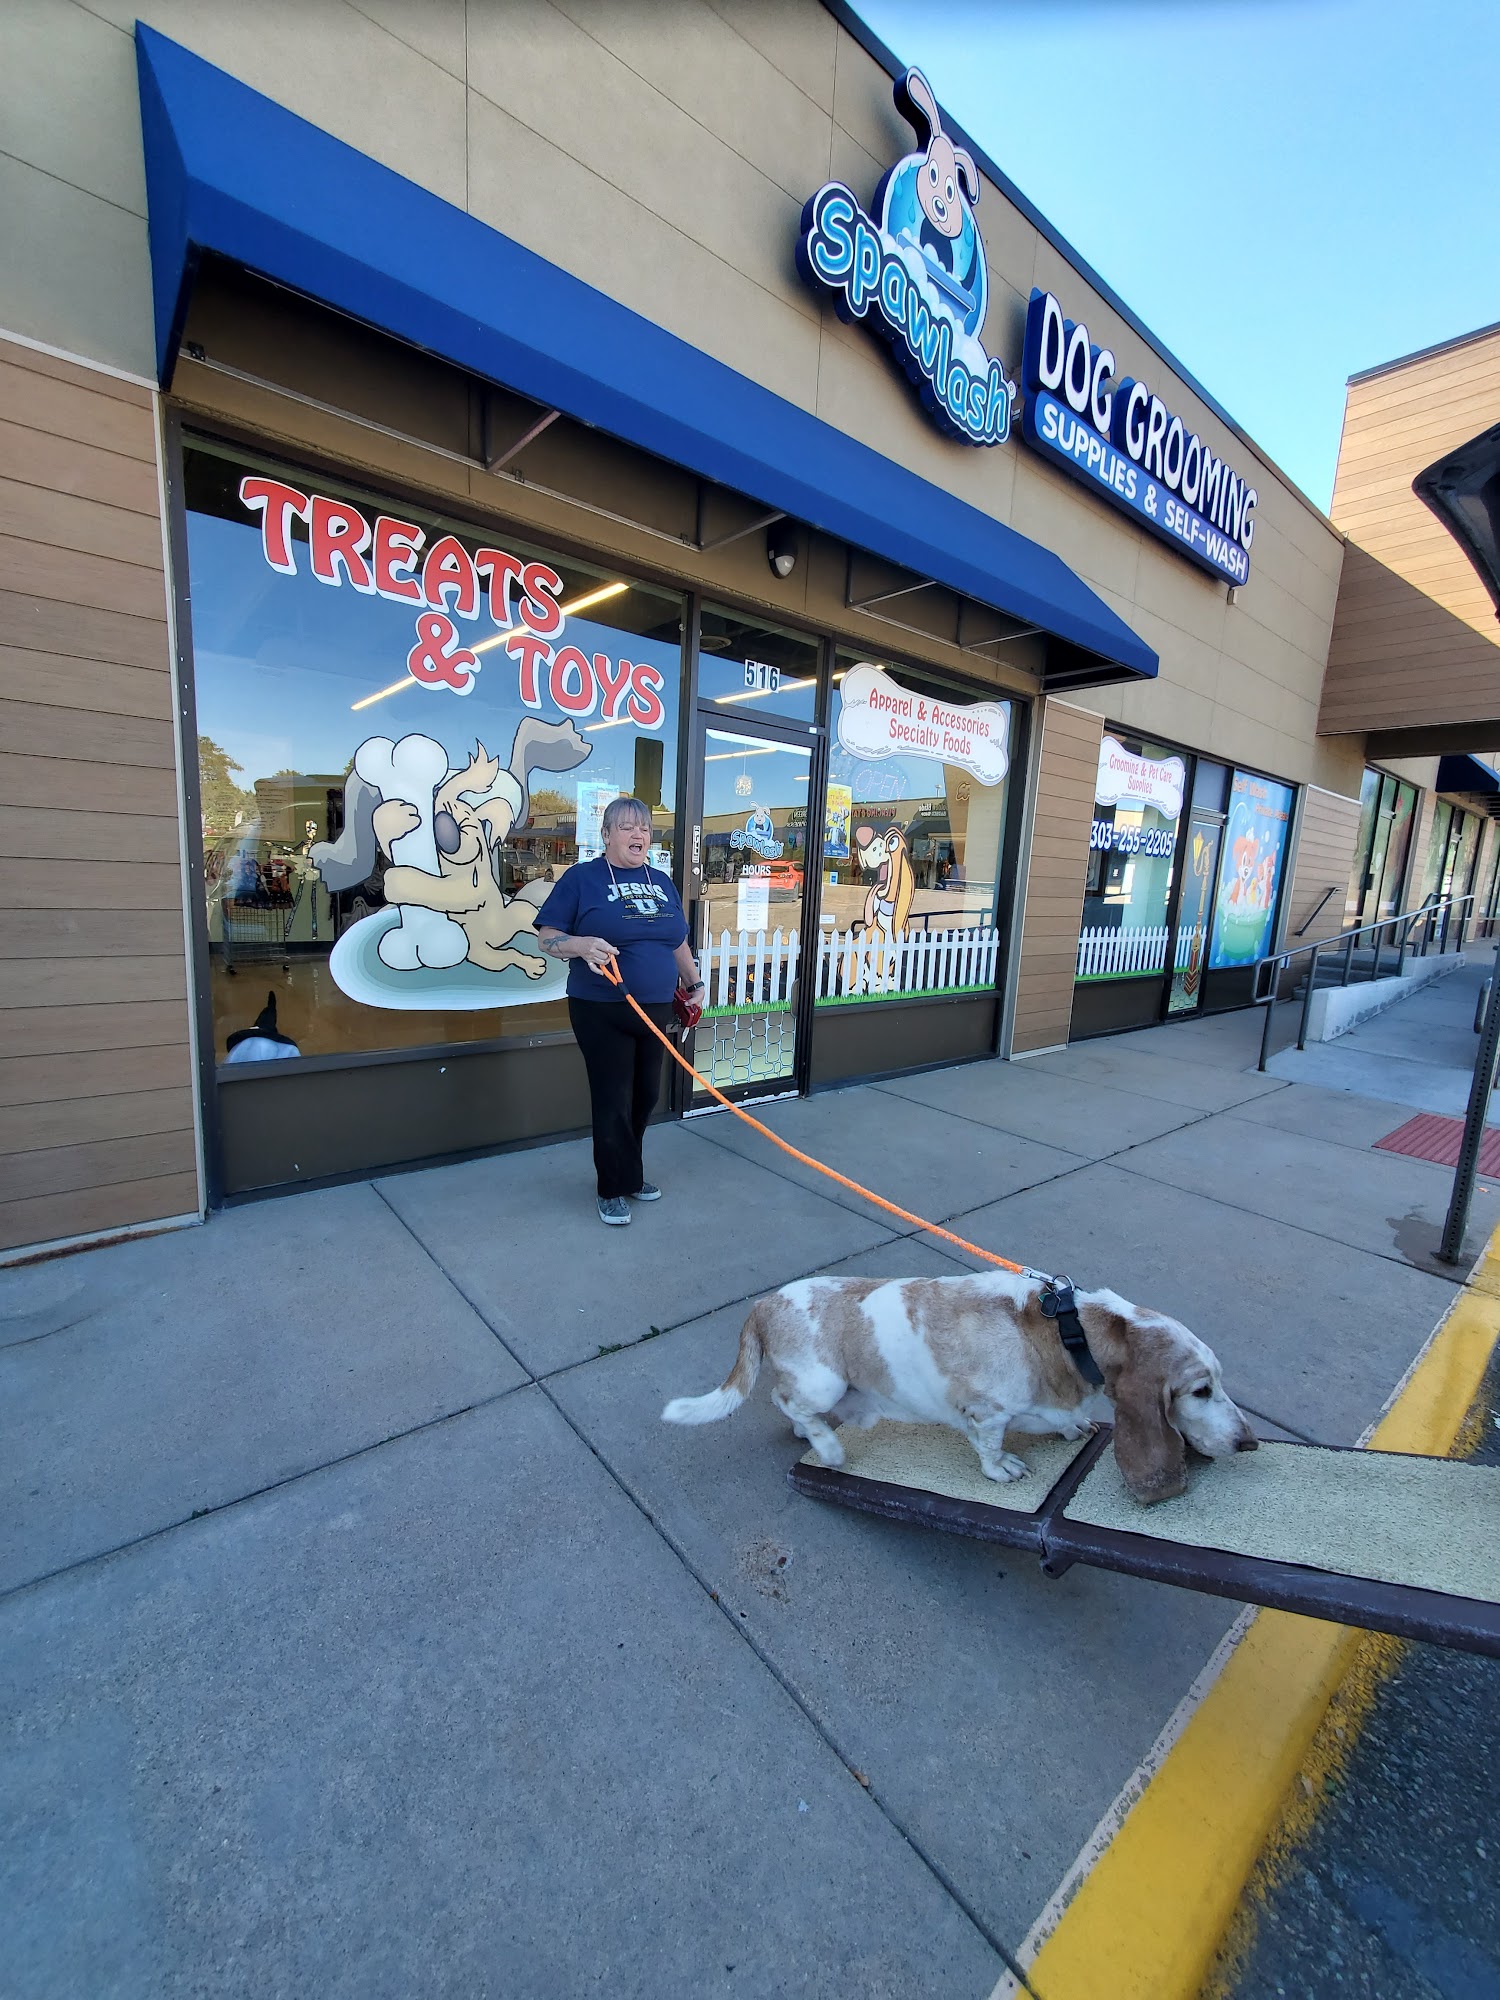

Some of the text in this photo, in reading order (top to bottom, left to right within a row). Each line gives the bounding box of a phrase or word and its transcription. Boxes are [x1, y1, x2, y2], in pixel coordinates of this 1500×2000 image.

[815, 197, 1008, 434] Spawlash
[1039, 292, 1258, 550] DOG GROOMING
[1042, 403, 1247, 580] SUPPLIES & SELF-WASH
[239, 476, 566, 640] TREATS
[407, 611, 665, 730] & TOYS
[746, 661, 778, 691] 516
[869, 688, 989, 737] Apparel & Accessories
[889, 718, 971, 755] Specialty Foods
[856, 769, 907, 801] OPEN
[1109, 754, 1172, 783] Grooming & Pet Care
[1127, 775, 1152, 794] Supplies
[731, 830, 783, 858] Spawlash
[1091, 821, 1174, 857] 303-255-2205
[742, 864, 771, 877] HOURS
[607, 883, 669, 902] JESUS
